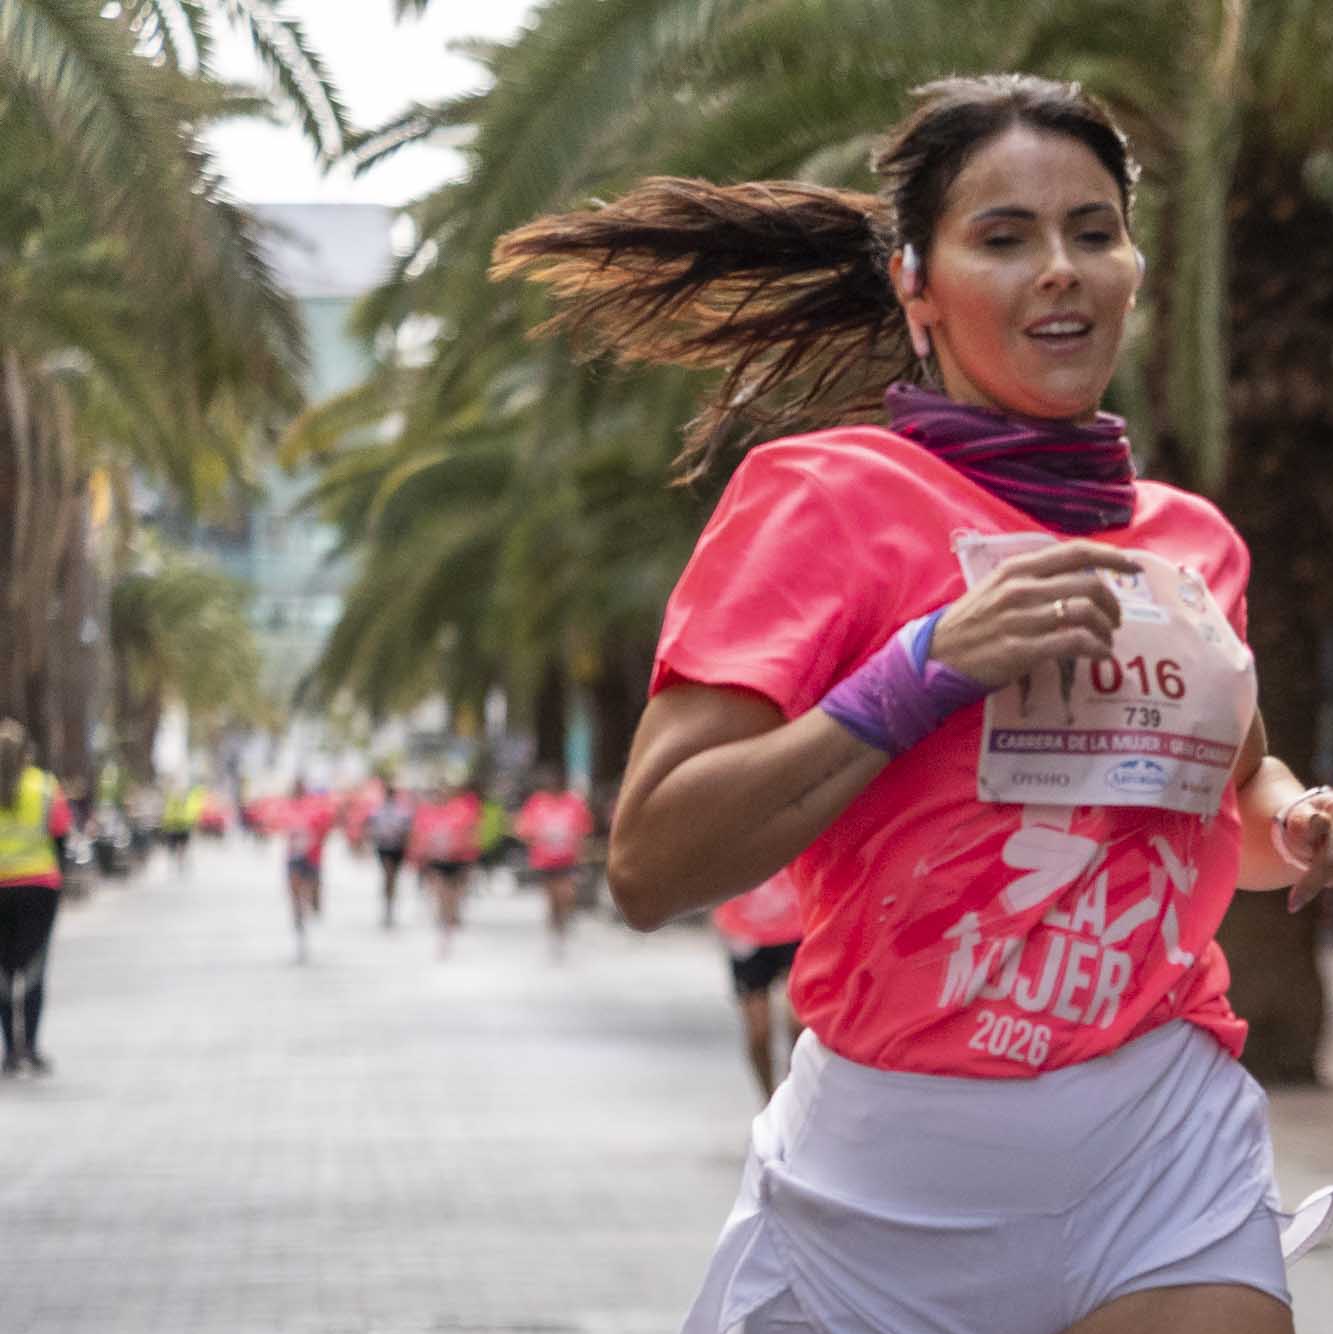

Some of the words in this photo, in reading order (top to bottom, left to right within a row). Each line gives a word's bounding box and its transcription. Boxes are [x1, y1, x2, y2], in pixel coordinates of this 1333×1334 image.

[1090, 654, 1185, 701] 016
[1124, 707, 1162, 728] 739
[997, 731, 1065, 751] CARRERA
[1067, 733, 1089, 751] DE
[1091, 734, 1110, 751] LA
[1112, 734, 1161, 753] MUJER
[937, 934, 1133, 1031] MUJER
[968, 1009, 1052, 1068] 2026
